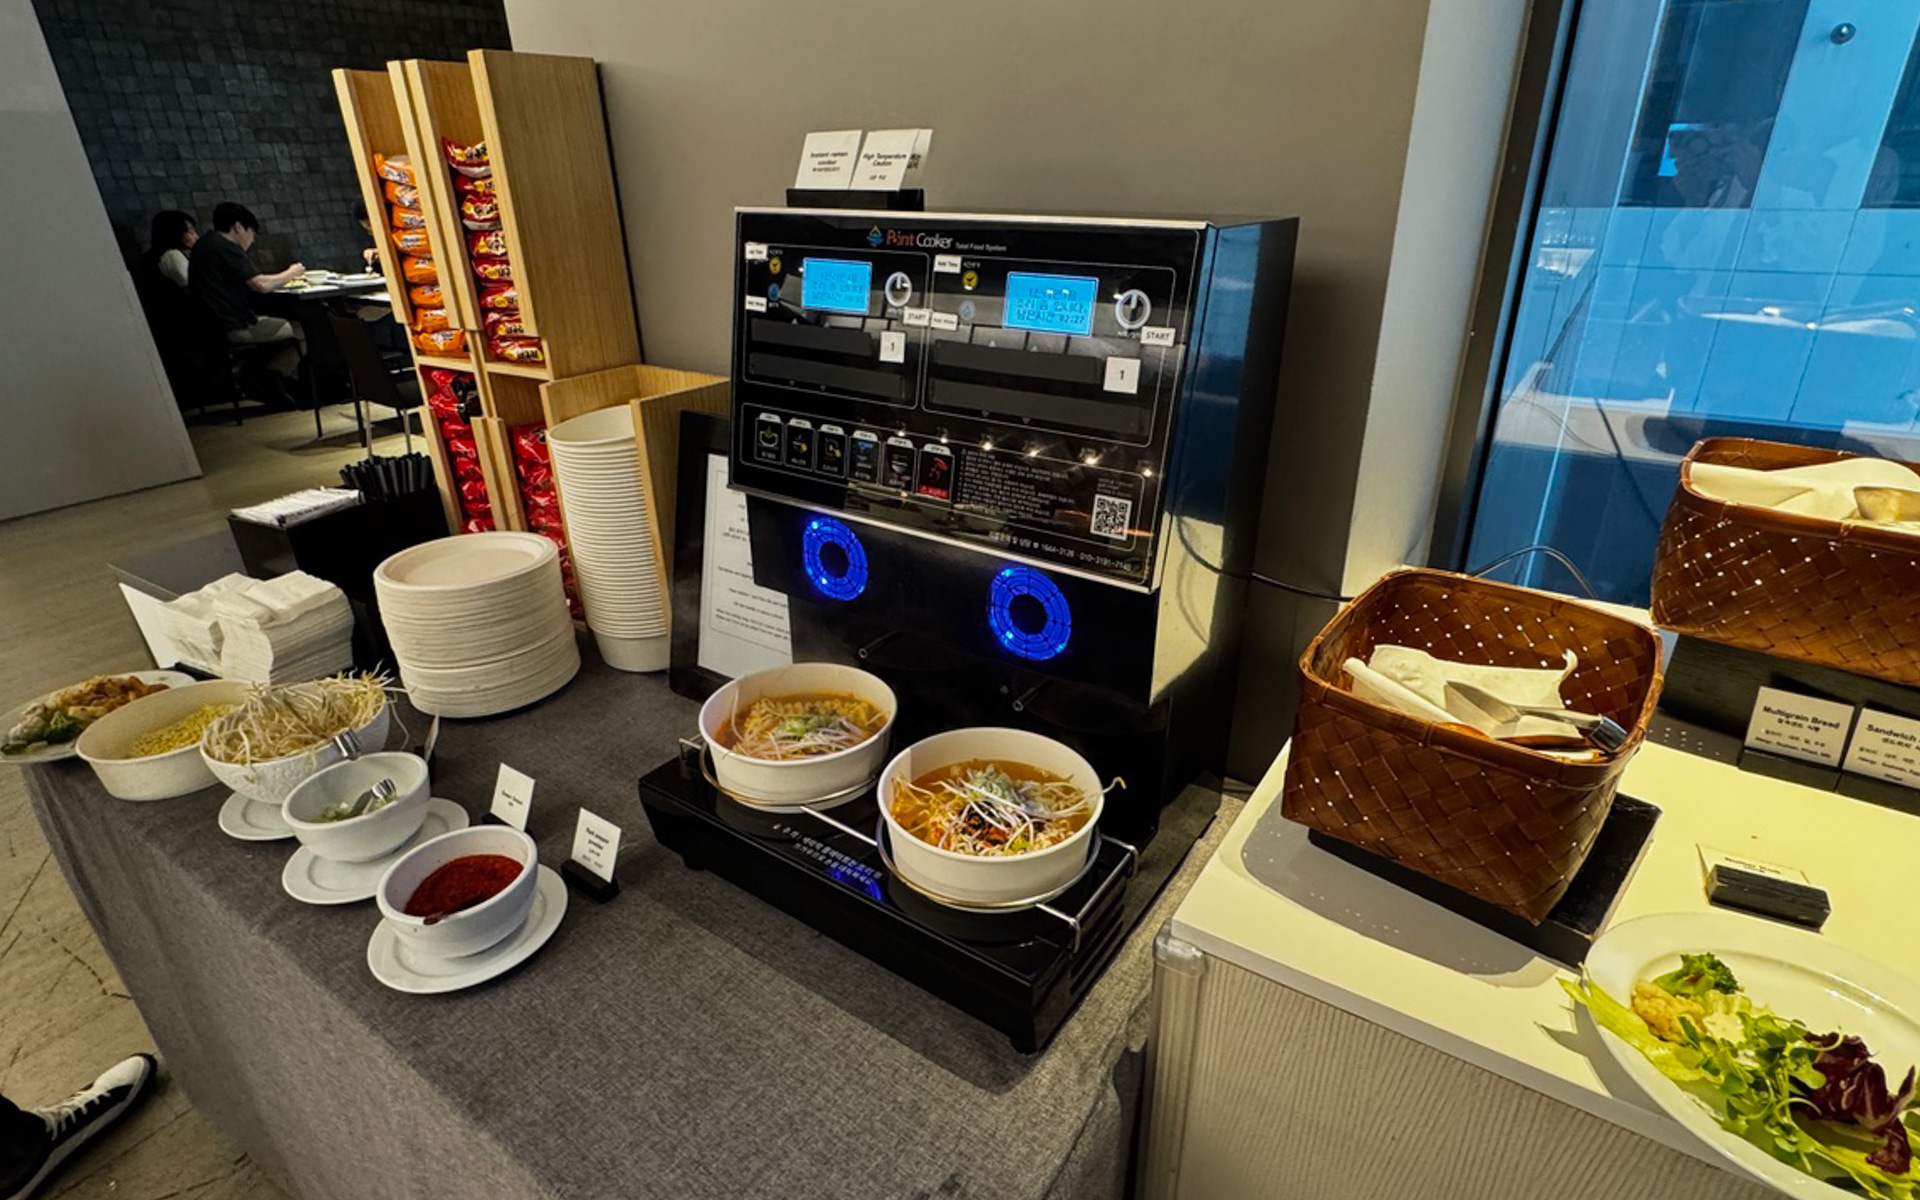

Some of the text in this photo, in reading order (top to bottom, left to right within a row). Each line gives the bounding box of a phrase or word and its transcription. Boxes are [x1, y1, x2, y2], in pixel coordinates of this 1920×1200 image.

[876, 152, 907, 160] Temperature
[916, 232, 953, 249] Cooker
[1146, 331, 1170, 340] START
[890, 342, 895, 352] 1
[1120, 369, 1125, 380] 1
[1763, 706, 1809, 722] Multigrain
[1811, 716, 1840, 729] Bread
[1866, 724, 1917, 741] Sandwich
